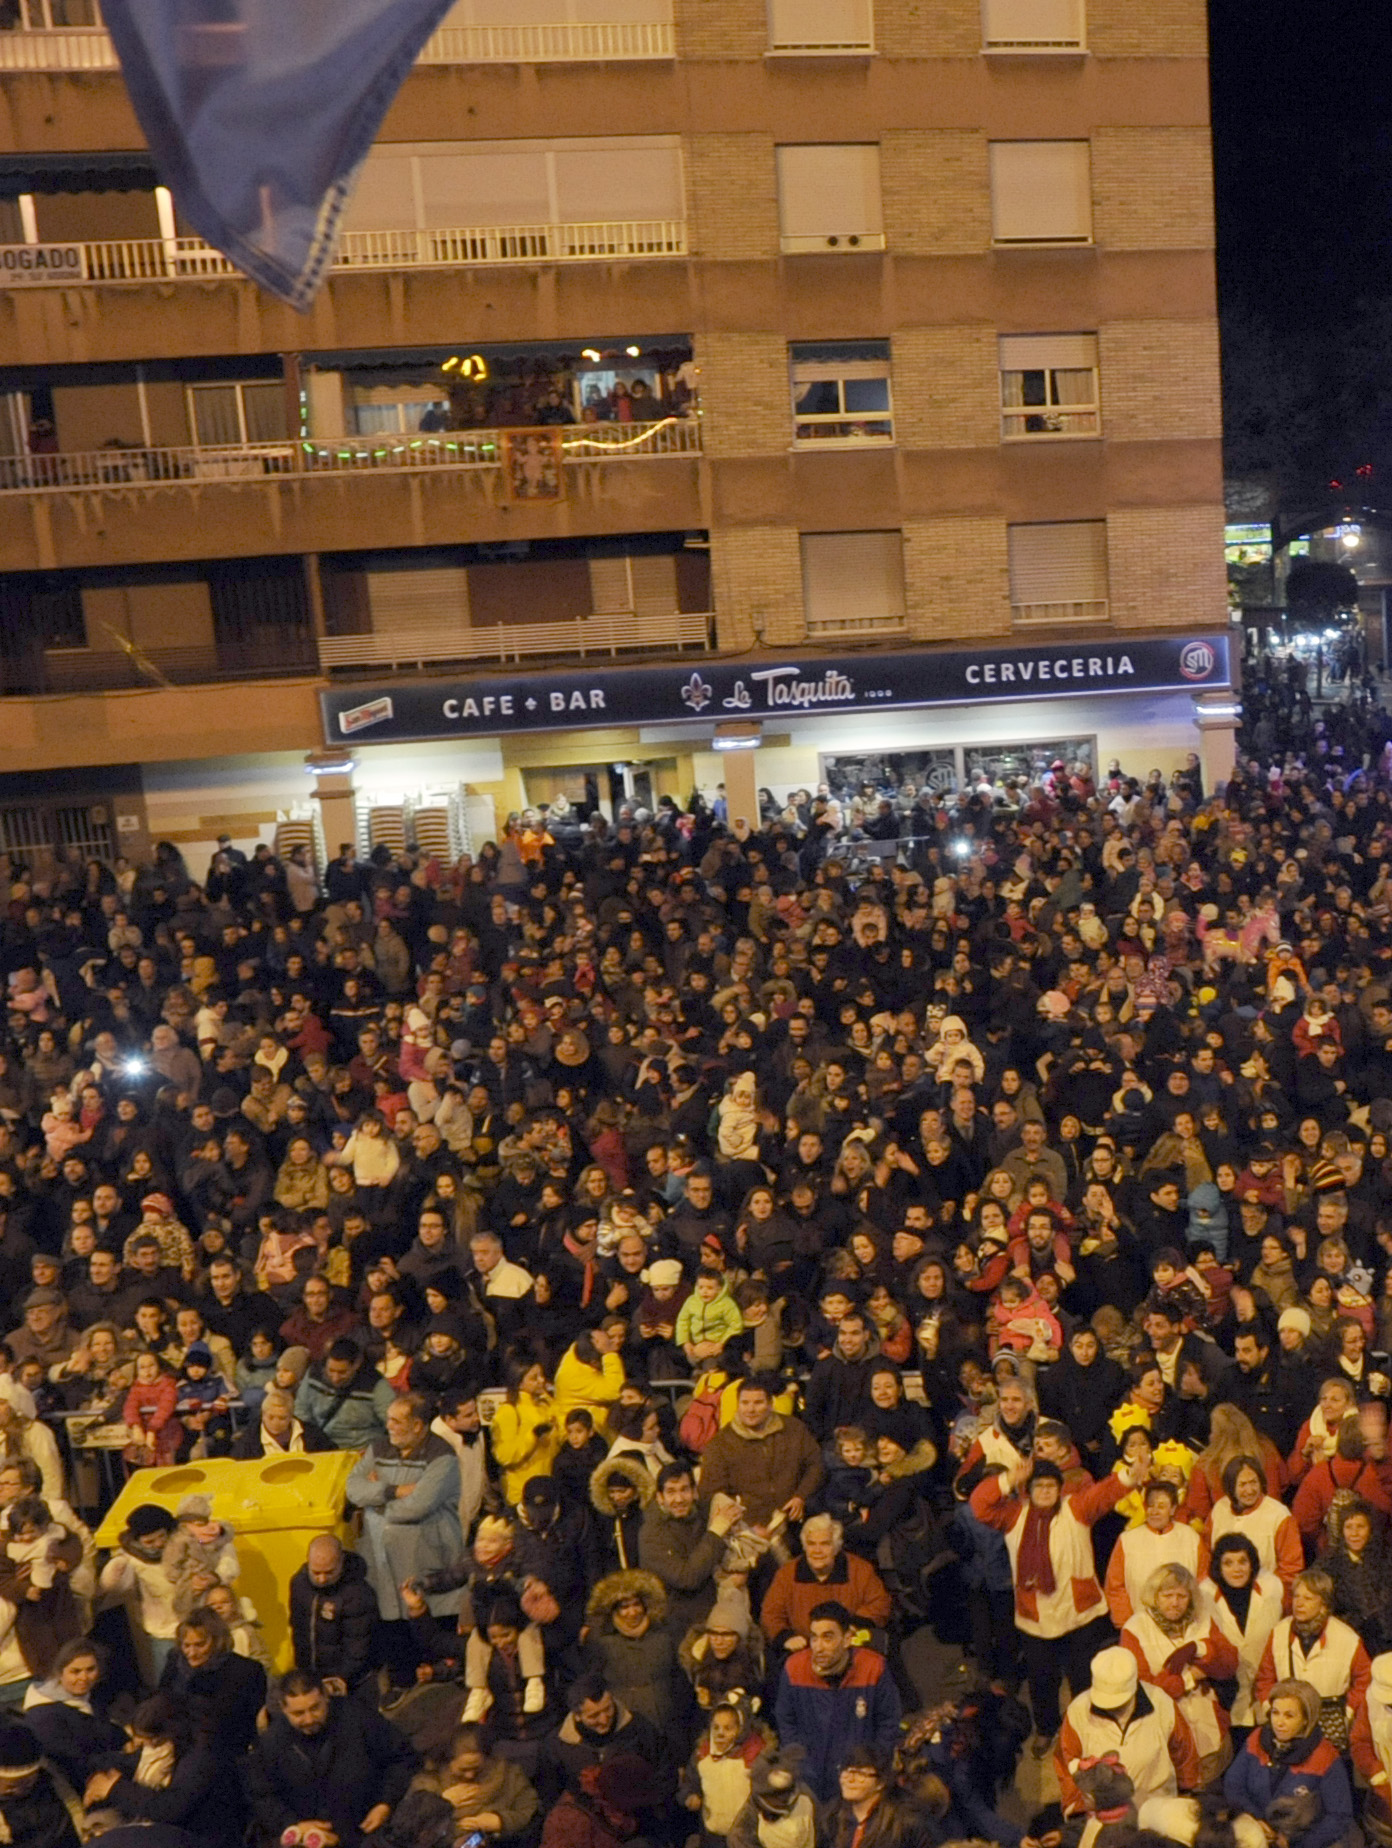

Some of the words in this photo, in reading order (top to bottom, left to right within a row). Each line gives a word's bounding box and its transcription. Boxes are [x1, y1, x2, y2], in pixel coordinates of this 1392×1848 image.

[0, 247, 79, 270] OGADO
[965, 655, 1135, 684] CERVECERIA
[722, 680, 752, 708] La
[751, 666, 856, 708] Tasquita
[442, 695, 514, 718] CAFE
[549, 689, 606, 711] BAR
